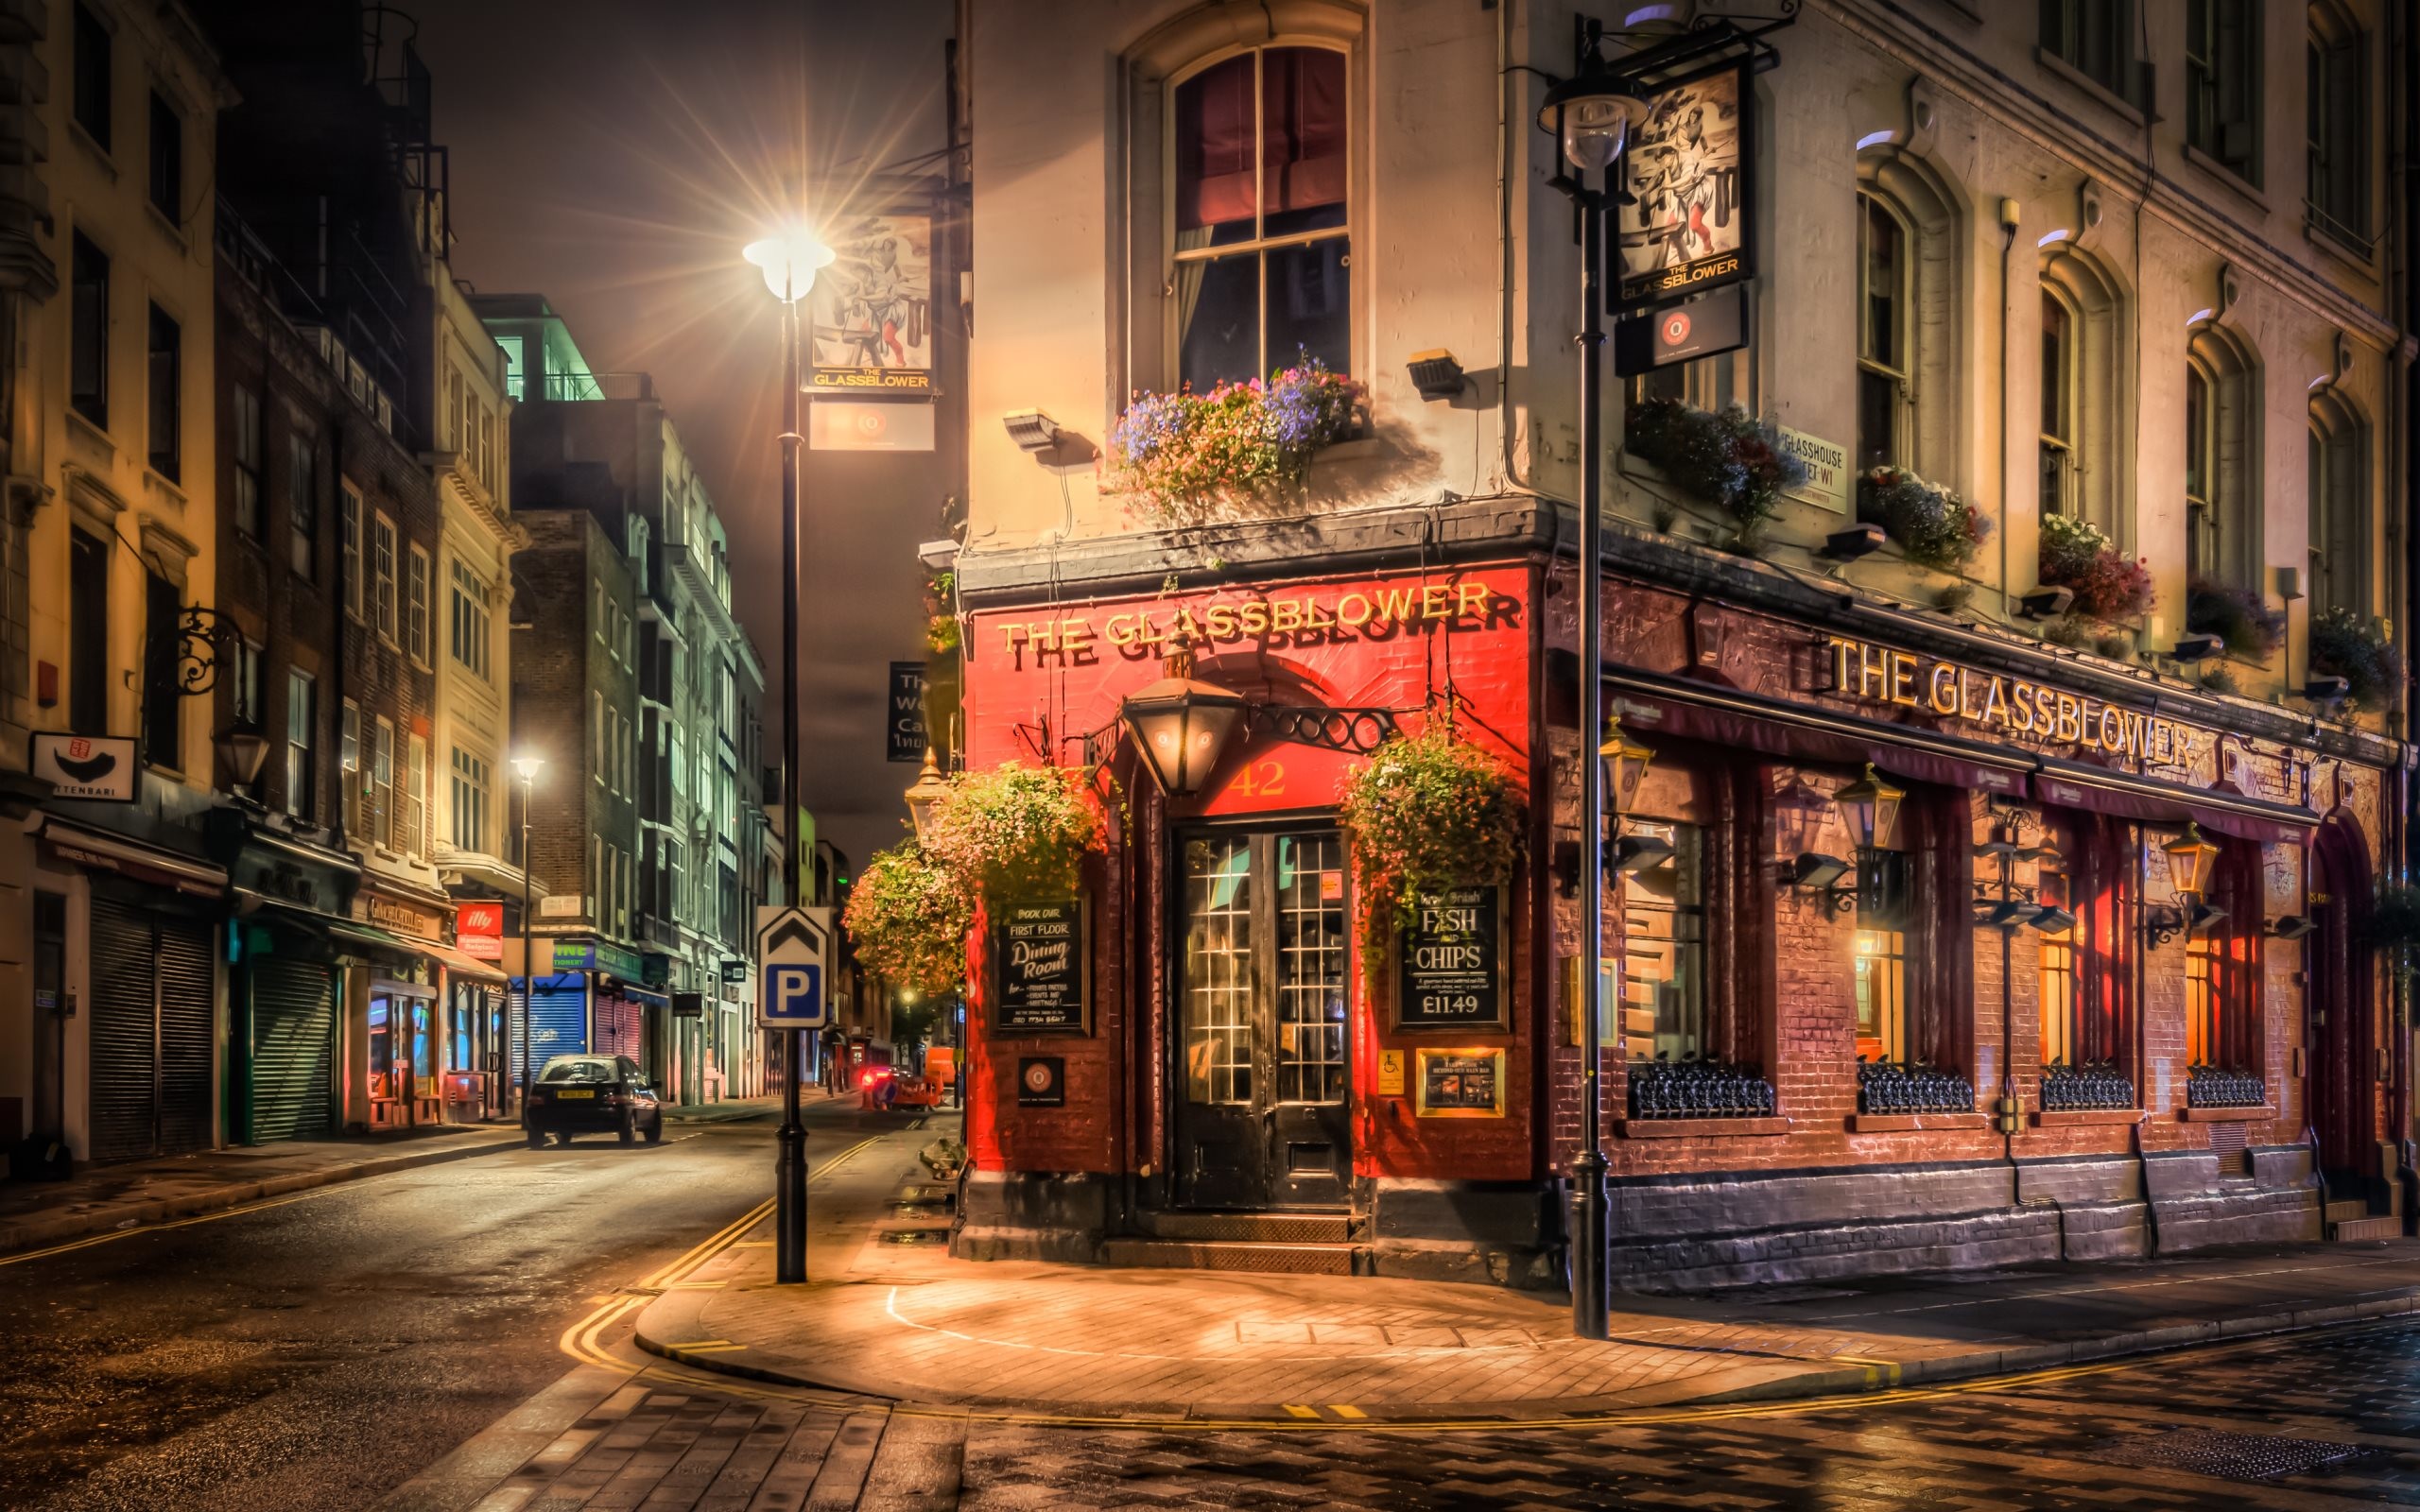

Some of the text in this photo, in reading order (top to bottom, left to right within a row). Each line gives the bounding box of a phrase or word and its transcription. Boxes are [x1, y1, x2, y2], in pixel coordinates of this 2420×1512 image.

[1621, 259, 1738, 300] GLASSBLOWER
[1669, 265, 1688, 275] THE
[814, 375, 929, 387] GLASSBLOWER
[1784, 434, 1842, 469] GLASSHOUSE
[997, 582, 1492, 653] THE GLASSBLOWER
[1829, 635, 2193, 767] THE GLASSBLOWER
[1228, 761, 1287, 798] 42
[467, 911, 493, 930] illy
[1018, 908, 1061, 919] BOOK OUR
[1422, 909, 1478, 932] FISH
[1010, 924, 1069, 936] FIRST FLOOR
[1011, 940, 1071, 967] Dining
[1416, 946, 1481, 969] CHIPS
[1024, 957, 1069, 979] Room
[777, 971, 810, 1012] P
[1423, 996, 1478, 1014] £11.49
